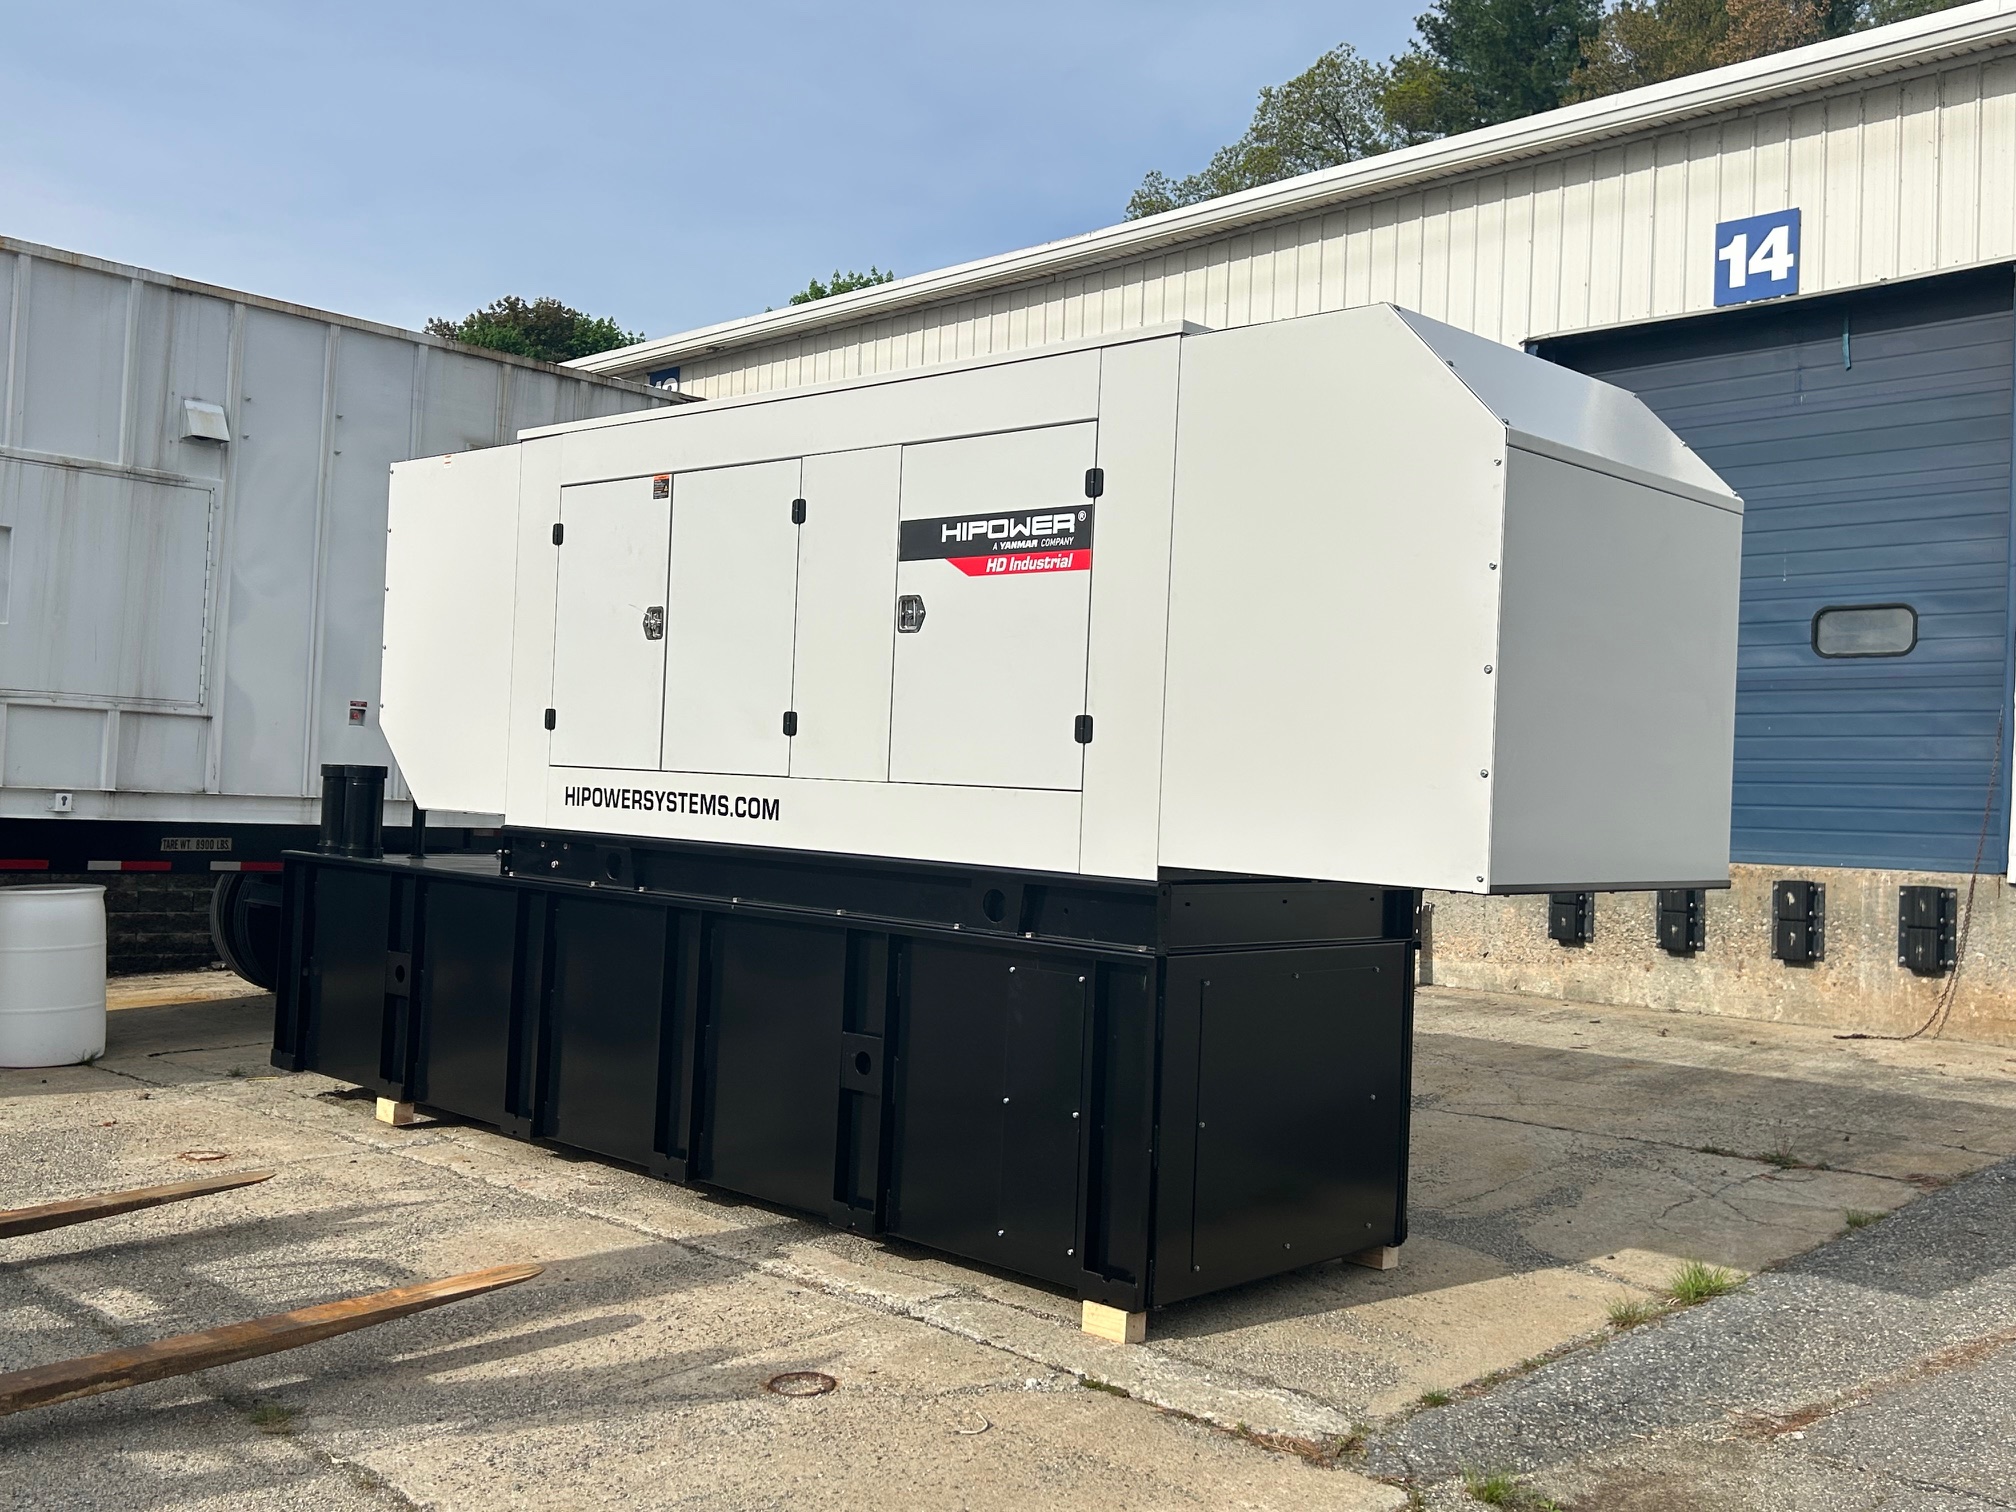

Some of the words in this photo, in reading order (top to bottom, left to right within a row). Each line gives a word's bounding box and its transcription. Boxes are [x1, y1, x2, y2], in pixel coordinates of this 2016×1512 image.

[1718, 225, 1794, 289] 14
[992, 542, 998, 551] A
[1000, 540, 1038, 550] YANMAR
[1040, 537, 1075, 548] COMPANY
[986, 557, 1007, 573] HD
[1009, 553, 1073, 571] Industrial
[565, 786, 780, 821] HIPOWERSYSTEMS.COM
[163, 839, 179, 849] TARE
